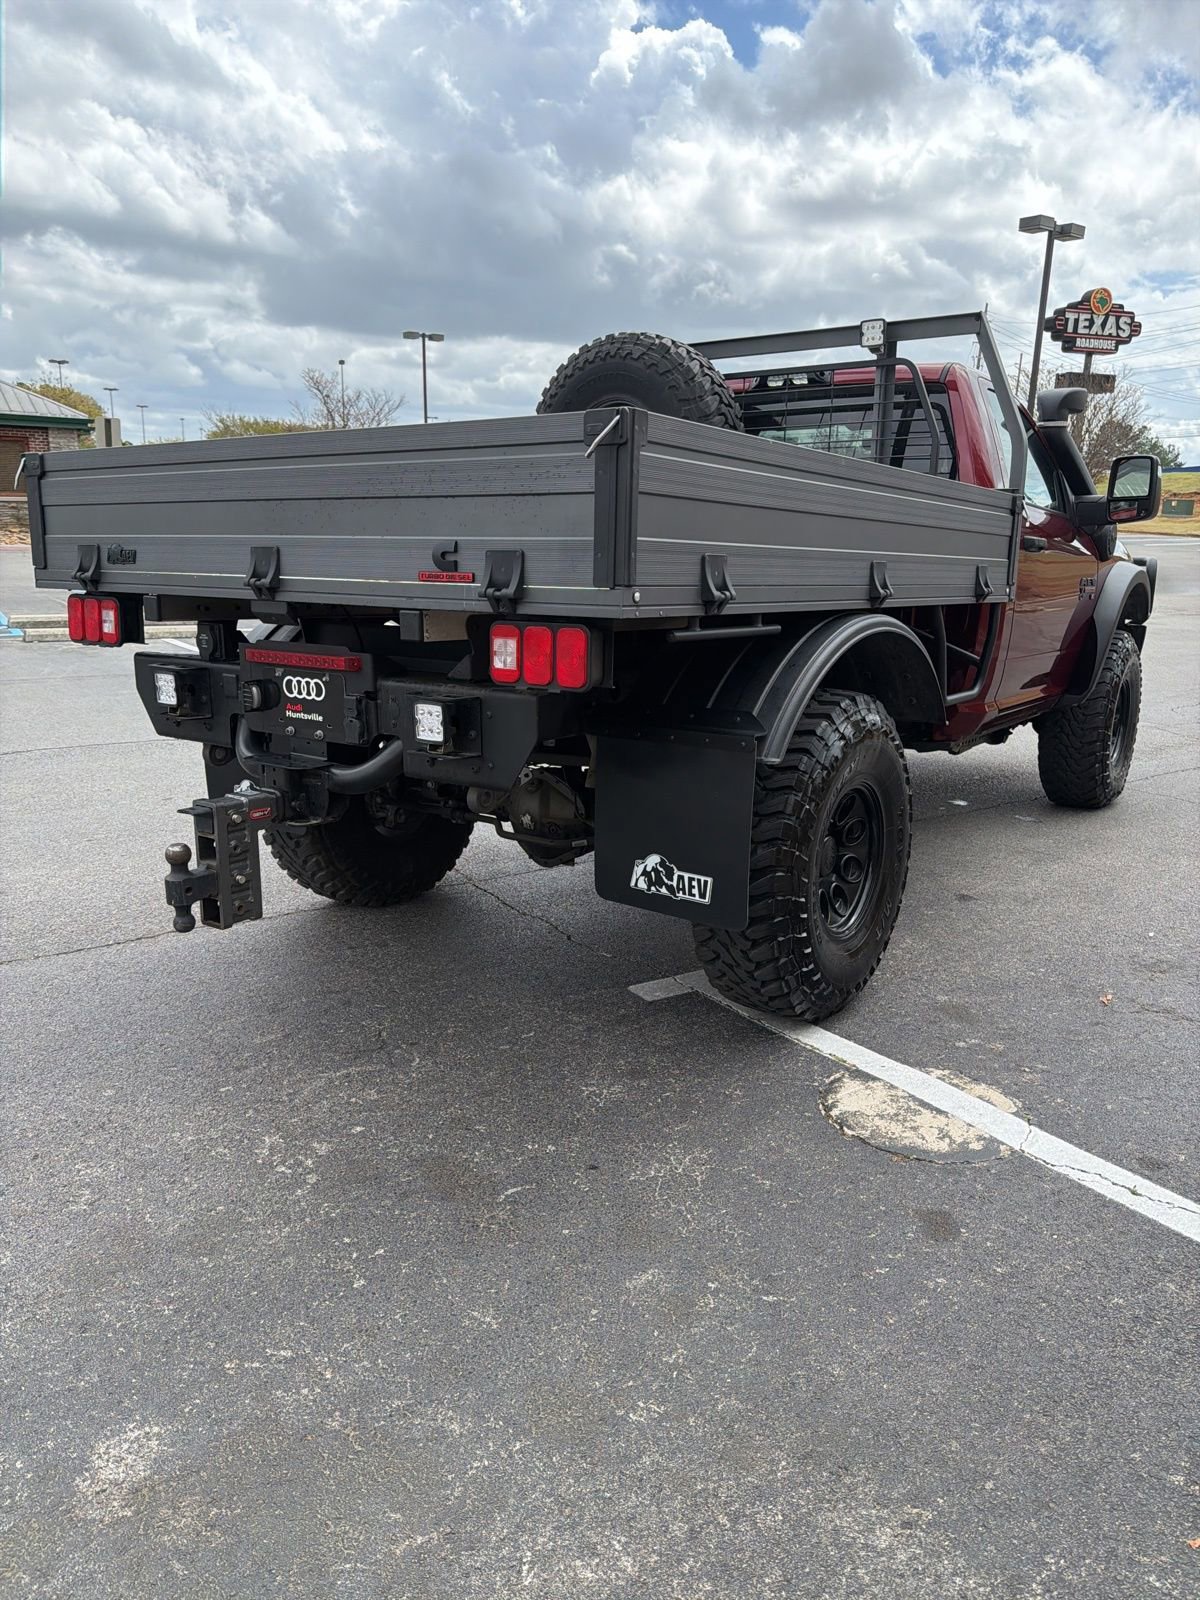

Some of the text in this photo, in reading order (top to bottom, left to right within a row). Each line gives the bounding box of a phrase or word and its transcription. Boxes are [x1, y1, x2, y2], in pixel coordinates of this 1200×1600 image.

[1065, 312, 1131, 337] TEXAS
[1075, 338, 1117, 350] ROADHOUSE
[445, 573, 472, 581] DIESEL
[286, 703, 303, 712] Audi
[286, 711, 323, 721] Huntsville
[675, 873, 709, 901] AEV
